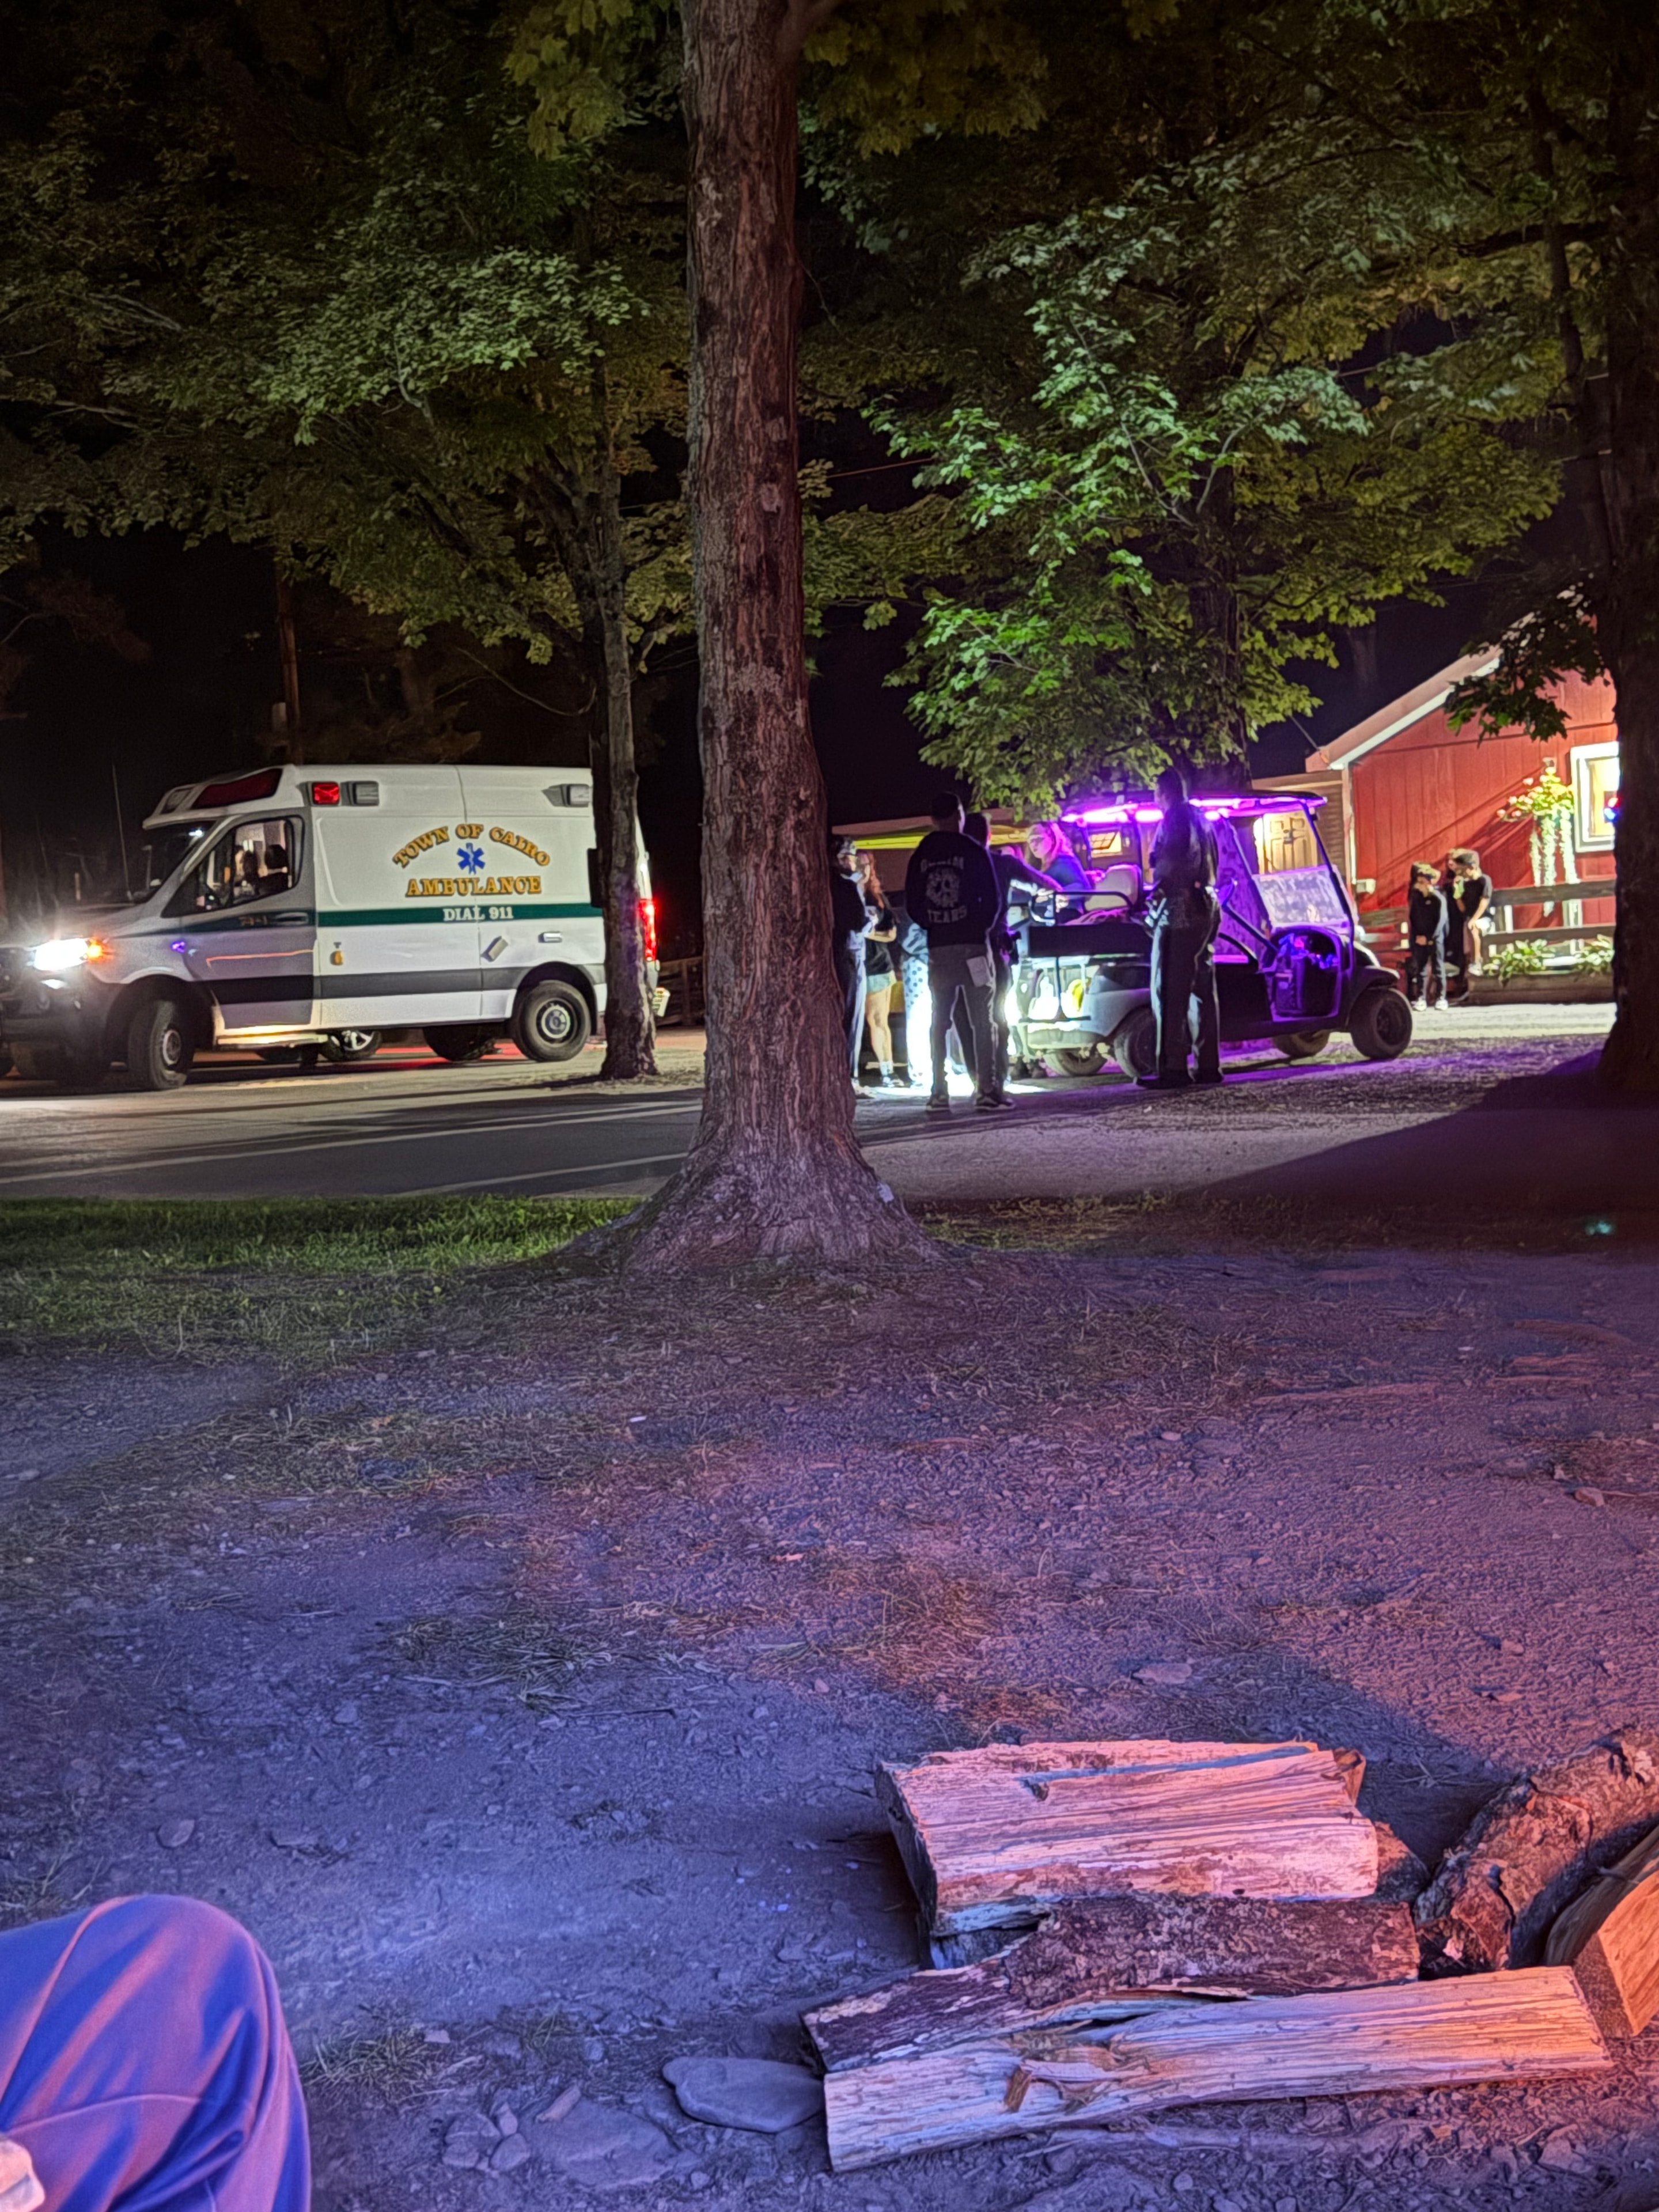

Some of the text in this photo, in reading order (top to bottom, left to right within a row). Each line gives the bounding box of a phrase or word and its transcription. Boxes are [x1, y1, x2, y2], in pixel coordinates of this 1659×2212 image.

[392, 823, 551, 868] TOWN OF CAIRO
[405, 876, 542, 897] AMBULANCE
[442, 906, 514, 922] DIAL 911
